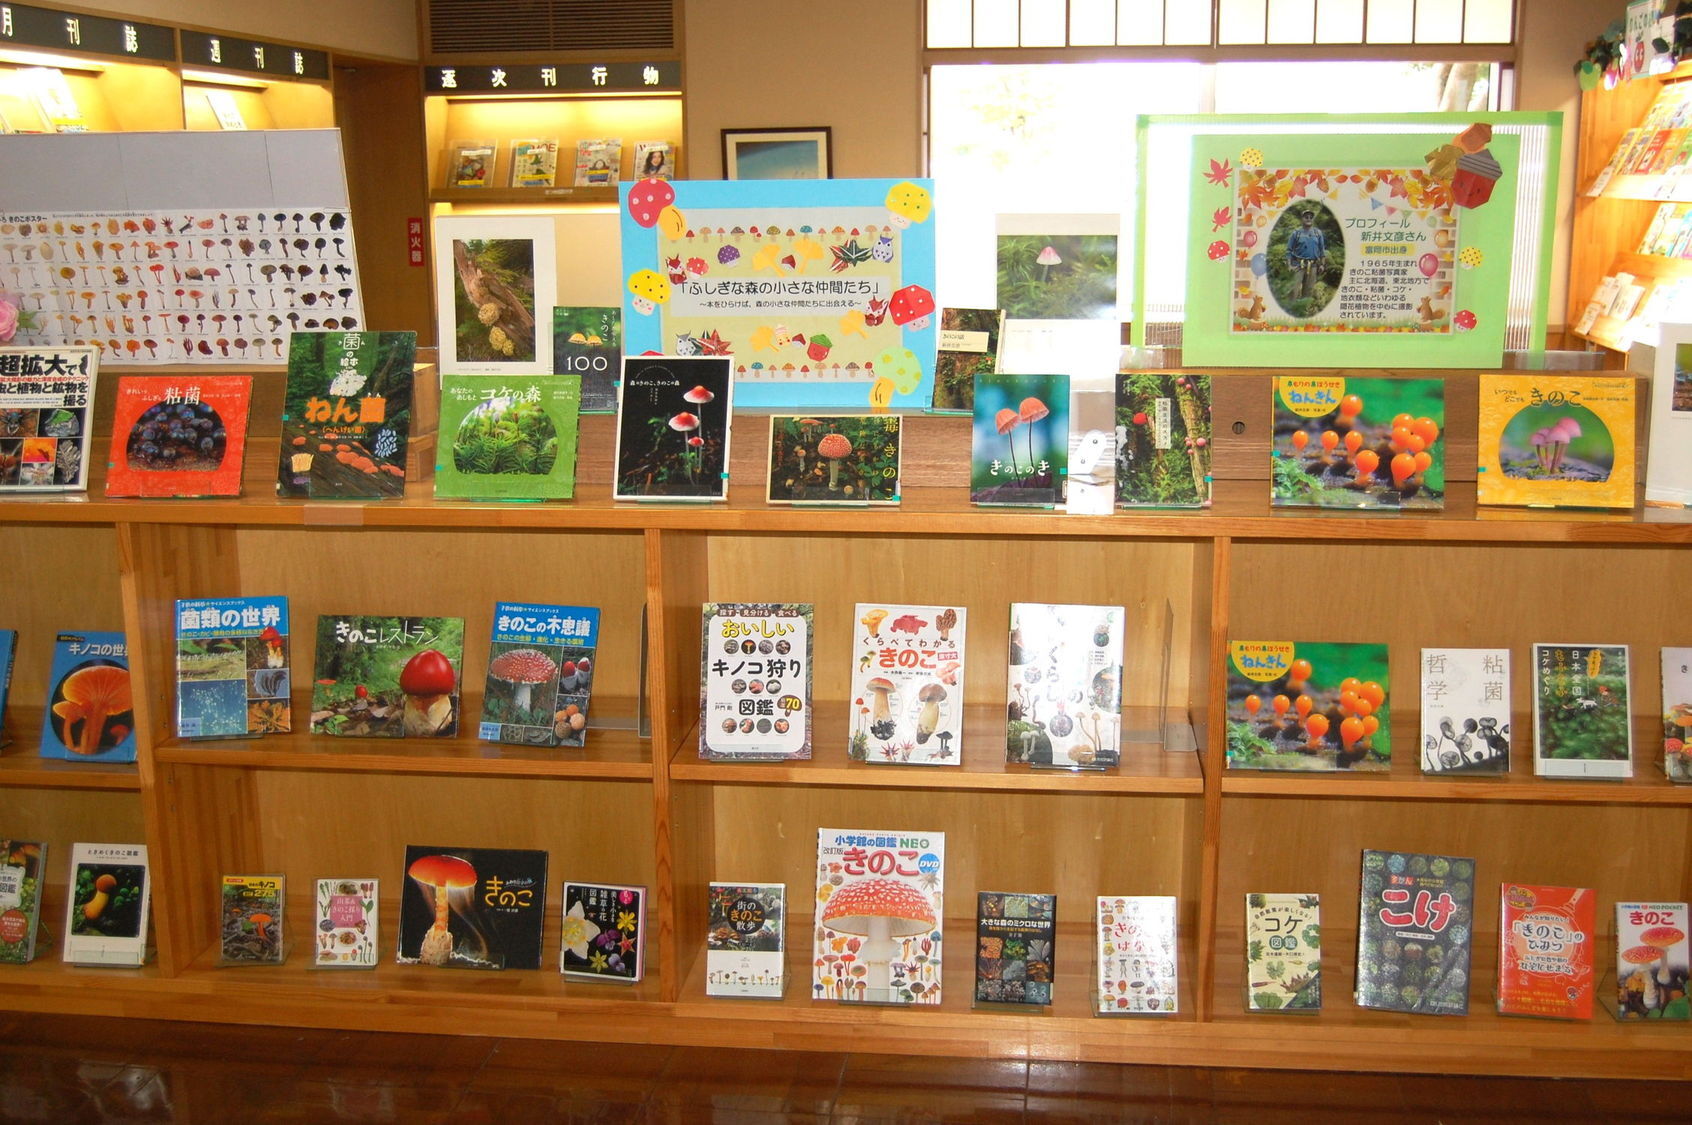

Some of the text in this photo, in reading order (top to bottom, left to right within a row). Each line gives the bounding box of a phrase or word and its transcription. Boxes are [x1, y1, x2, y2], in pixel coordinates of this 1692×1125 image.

[1345, 218, 1410, 229] プロフィール
[1361, 231, 1426, 242] 新井文彦さん
[679, 281, 881, 295] 「ふしぎな森の小さな仲間たち」
[601, 314, 609, 341] きのこ
[566, 356, 608, 371] 100
[63, 395, 87, 406] 撮る
[164, 386, 201, 405] 粘菌
[480, 385, 541, 403] コケの森
[1288, 389, 1337, 404] ねんきん
[1530, 387, 1582, 407] きのこ
[990, 459, 1050, 476] きのこのき
[181, 605, 281, 629] 菌類の世界
[498, 615, 591, 637] きのこの不思議
[336, 620, 439, 645] きのこレストラン
[721, 619, 795, 638] おいしい
[863, 637, 956, 649] くらべてわかる
[879, 647, 936, 669] きのこ
[1240, 654, 1287, 669] ねんきん
[712, 659, 801, 678] キノコ狩り
[1427, 654, 1448, 700] 哲学
[1542, 650, 1550, 695] コケめぐり
[1572, 650, 1581, 695] 日本全国
[1482, 655, 1505, 701] 粘菌
[739, 699, 774, 716] 図鑑
[785, 698, 800, 710] 70
[835, 835, 929, 849] 小学館の図鑑 NEO
[842, 847, 920, 876] きのこ
[919, 860, 939, 868] DVD
[485, 875, 533, 906] きのこ
[737, 901, 756, 910] 街の
[1380, 889, 1456, 932] こけ
[731, 909, 762, 921] きのこ
[981, 919, 1051, 928] 大きな森のミクロな世界
[1629, 910, 1674, 925] きのこ
[736, 921, 756, 931] 散歩
[1265, 915, 1303, 934] コケ
[1514, 922, 1583, 942] 「きのこ」の
[1270, 937, 1296, 949] 図鑑
[1528, 940, 1563, 951] ひみつ
